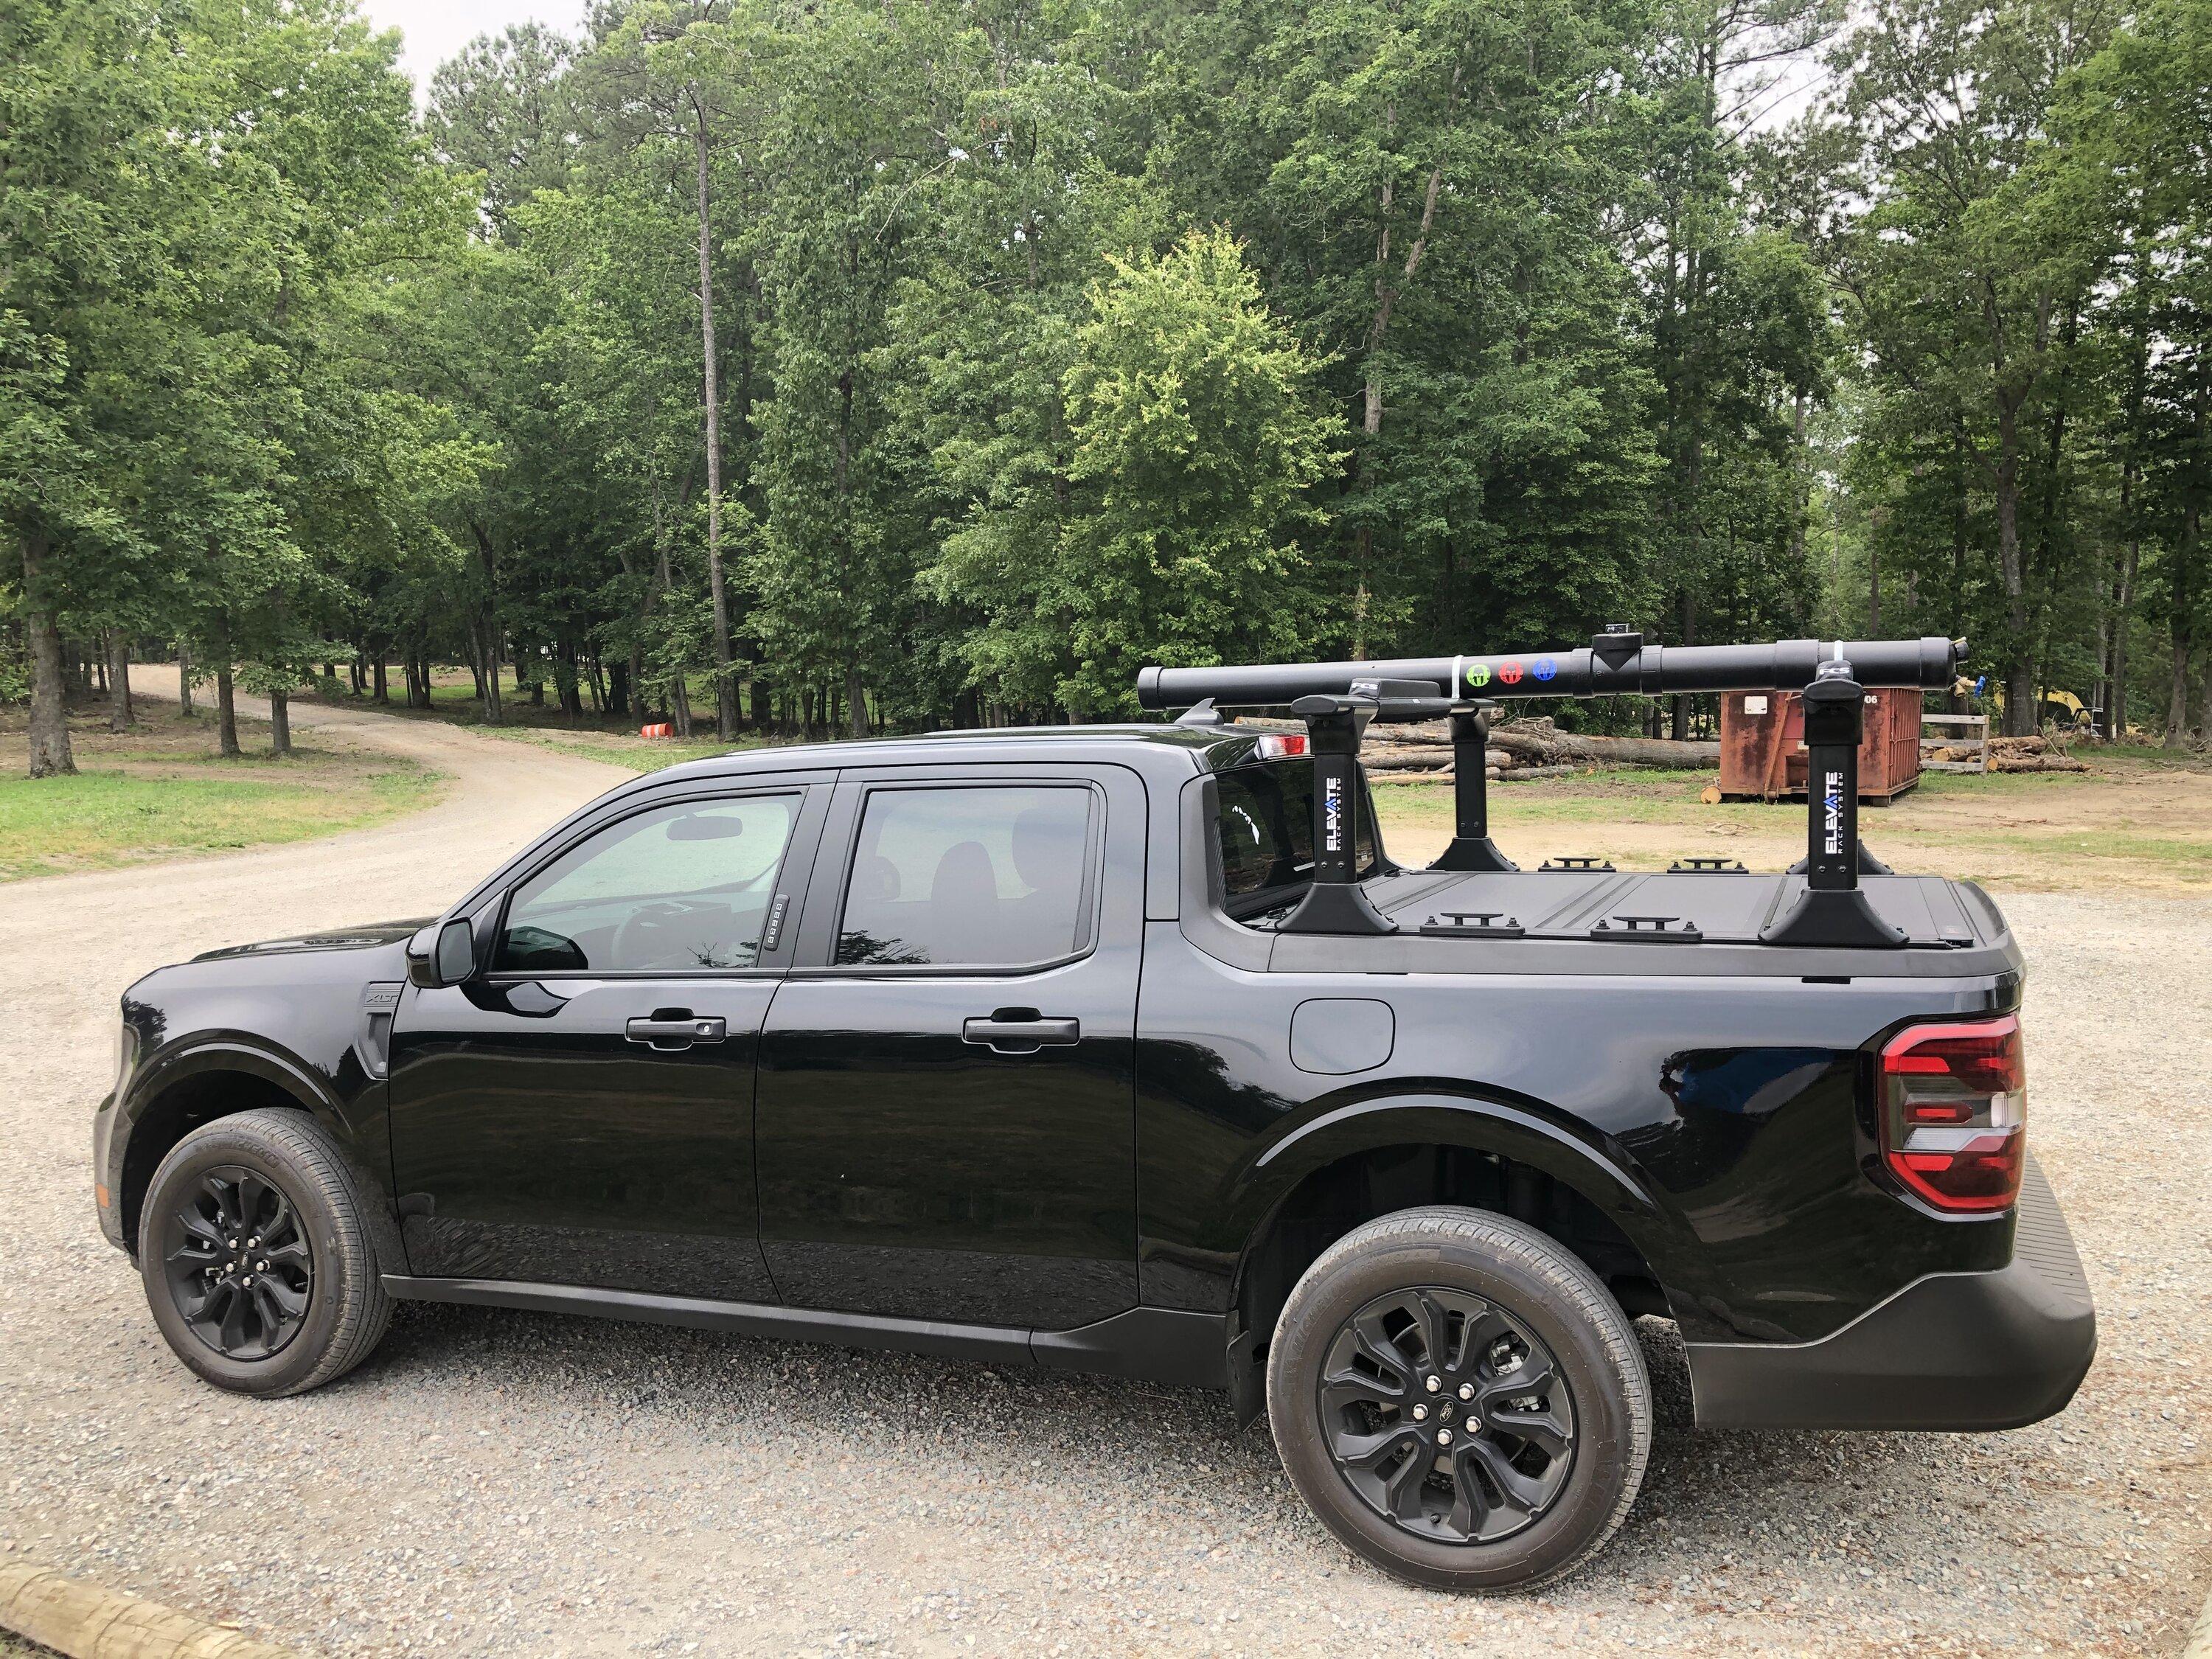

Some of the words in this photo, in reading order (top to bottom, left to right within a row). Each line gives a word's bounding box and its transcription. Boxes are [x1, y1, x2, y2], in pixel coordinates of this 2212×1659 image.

[1863, 695, 1878, 704] 06
[1324, 777, 1337, 852] ELEVATE
[1823, 771, 1839, 855] ELEVATE
[366, 994, 399, 1003] XLT
